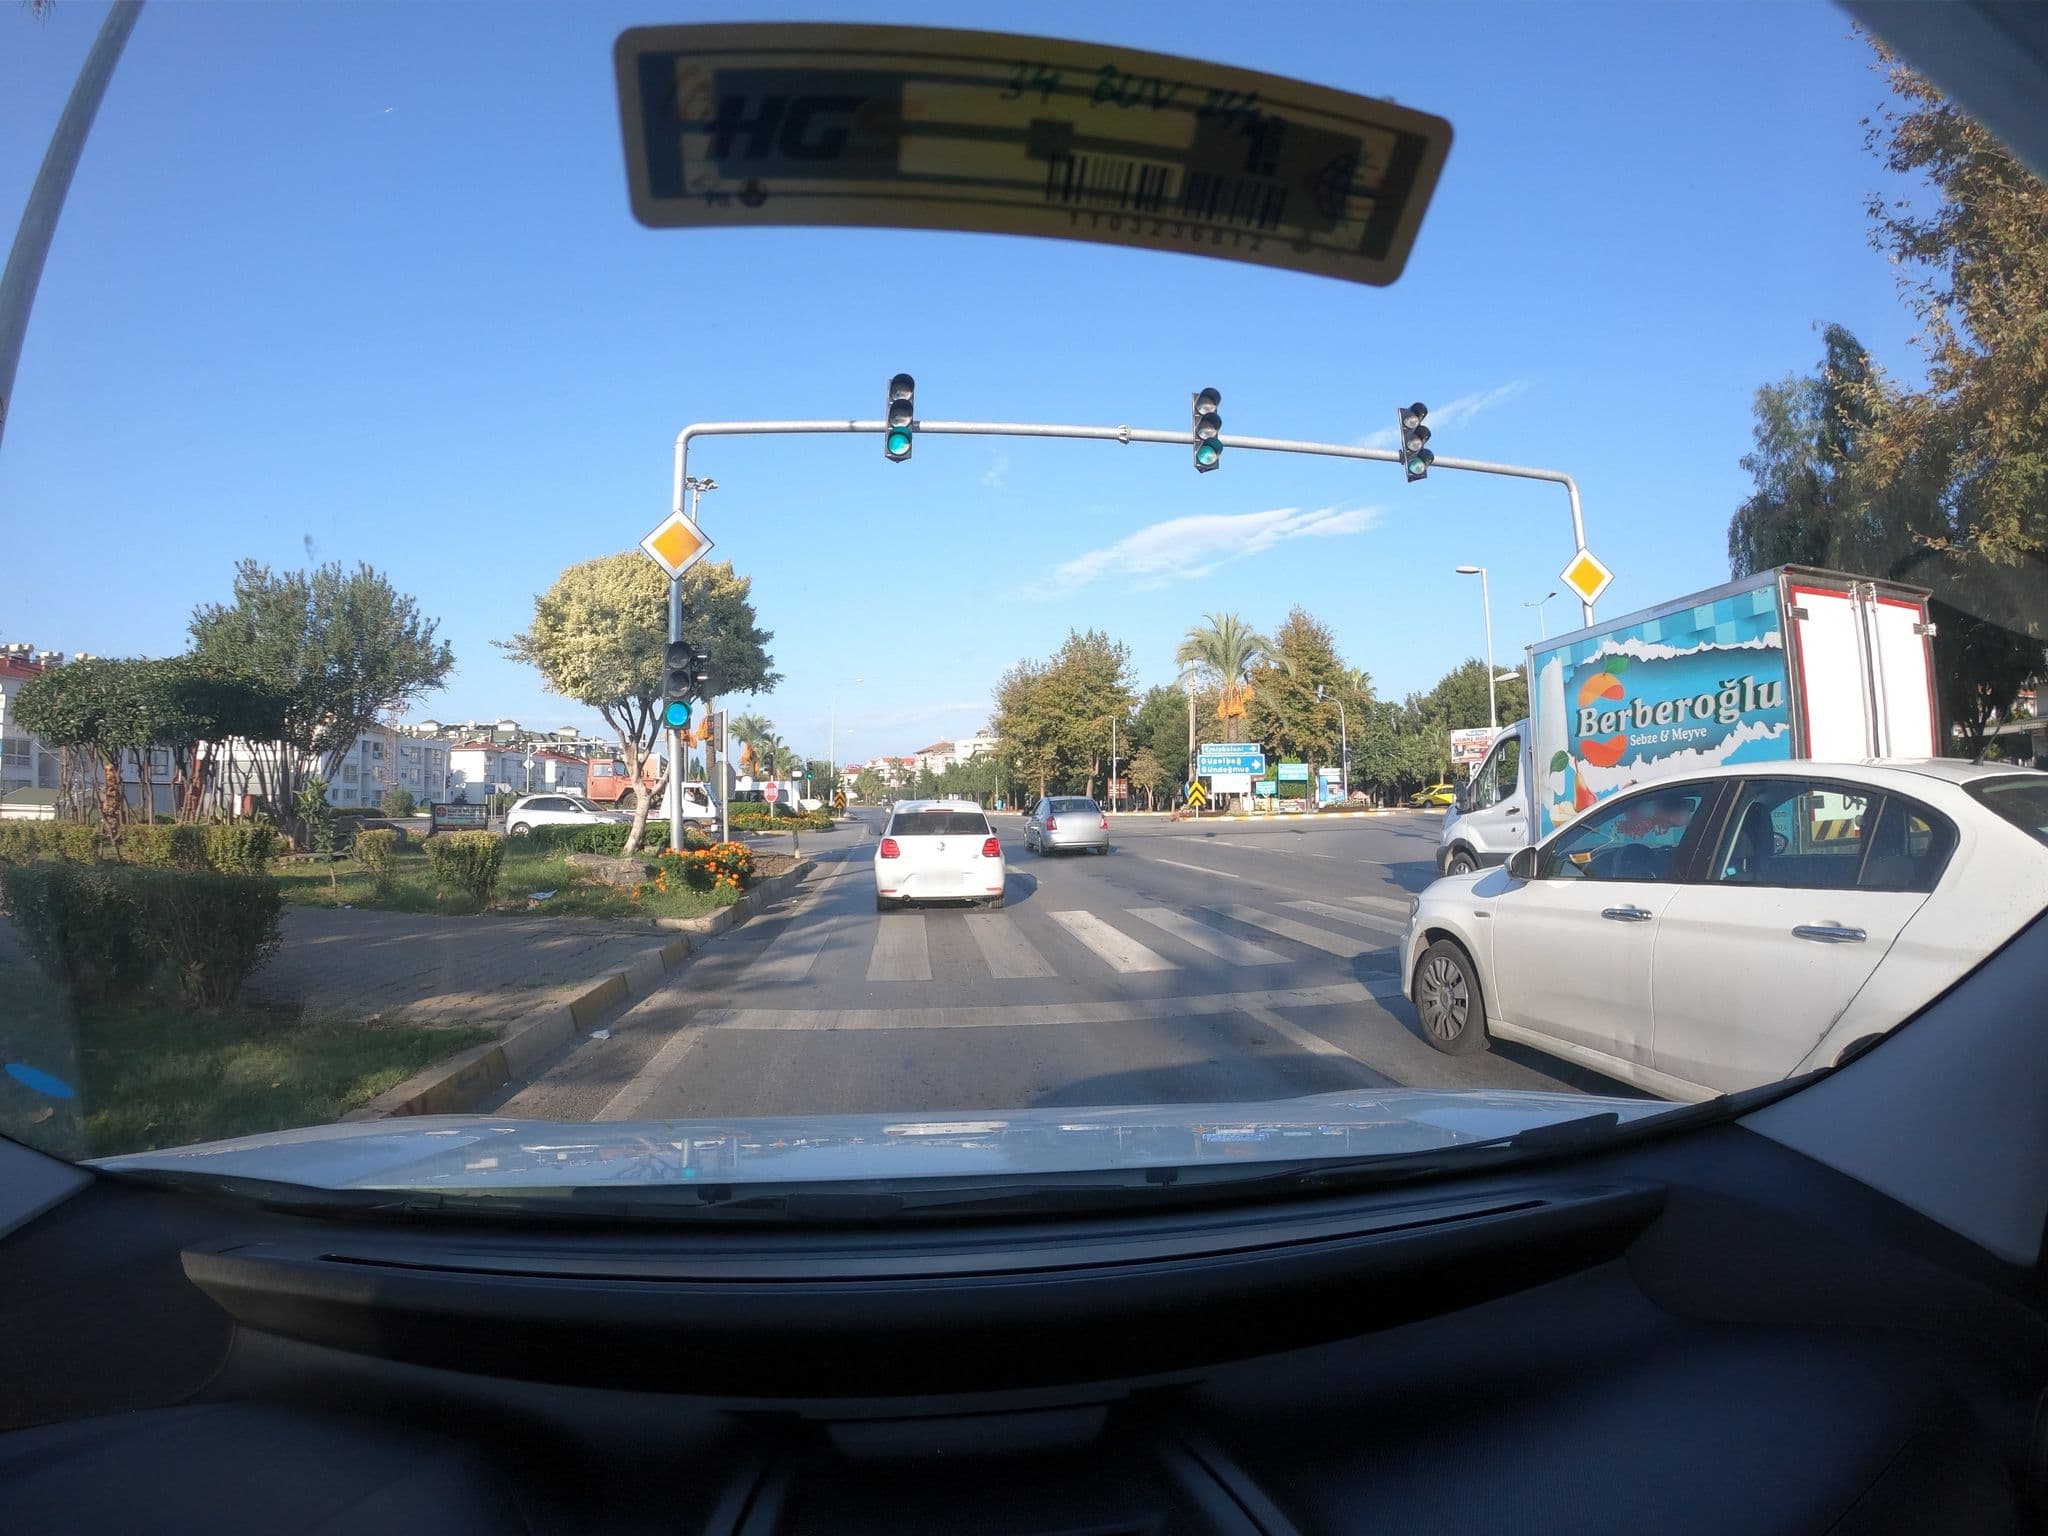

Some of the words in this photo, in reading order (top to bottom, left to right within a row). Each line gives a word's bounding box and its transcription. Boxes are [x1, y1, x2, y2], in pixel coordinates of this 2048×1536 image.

[1576, 675, 1783, 737] Berberoğlu
[1630, 733, 1657, 746] Sebze
[1660, 730, 1669, 742] &
[1672, 727, 1707, 743] Meyve
